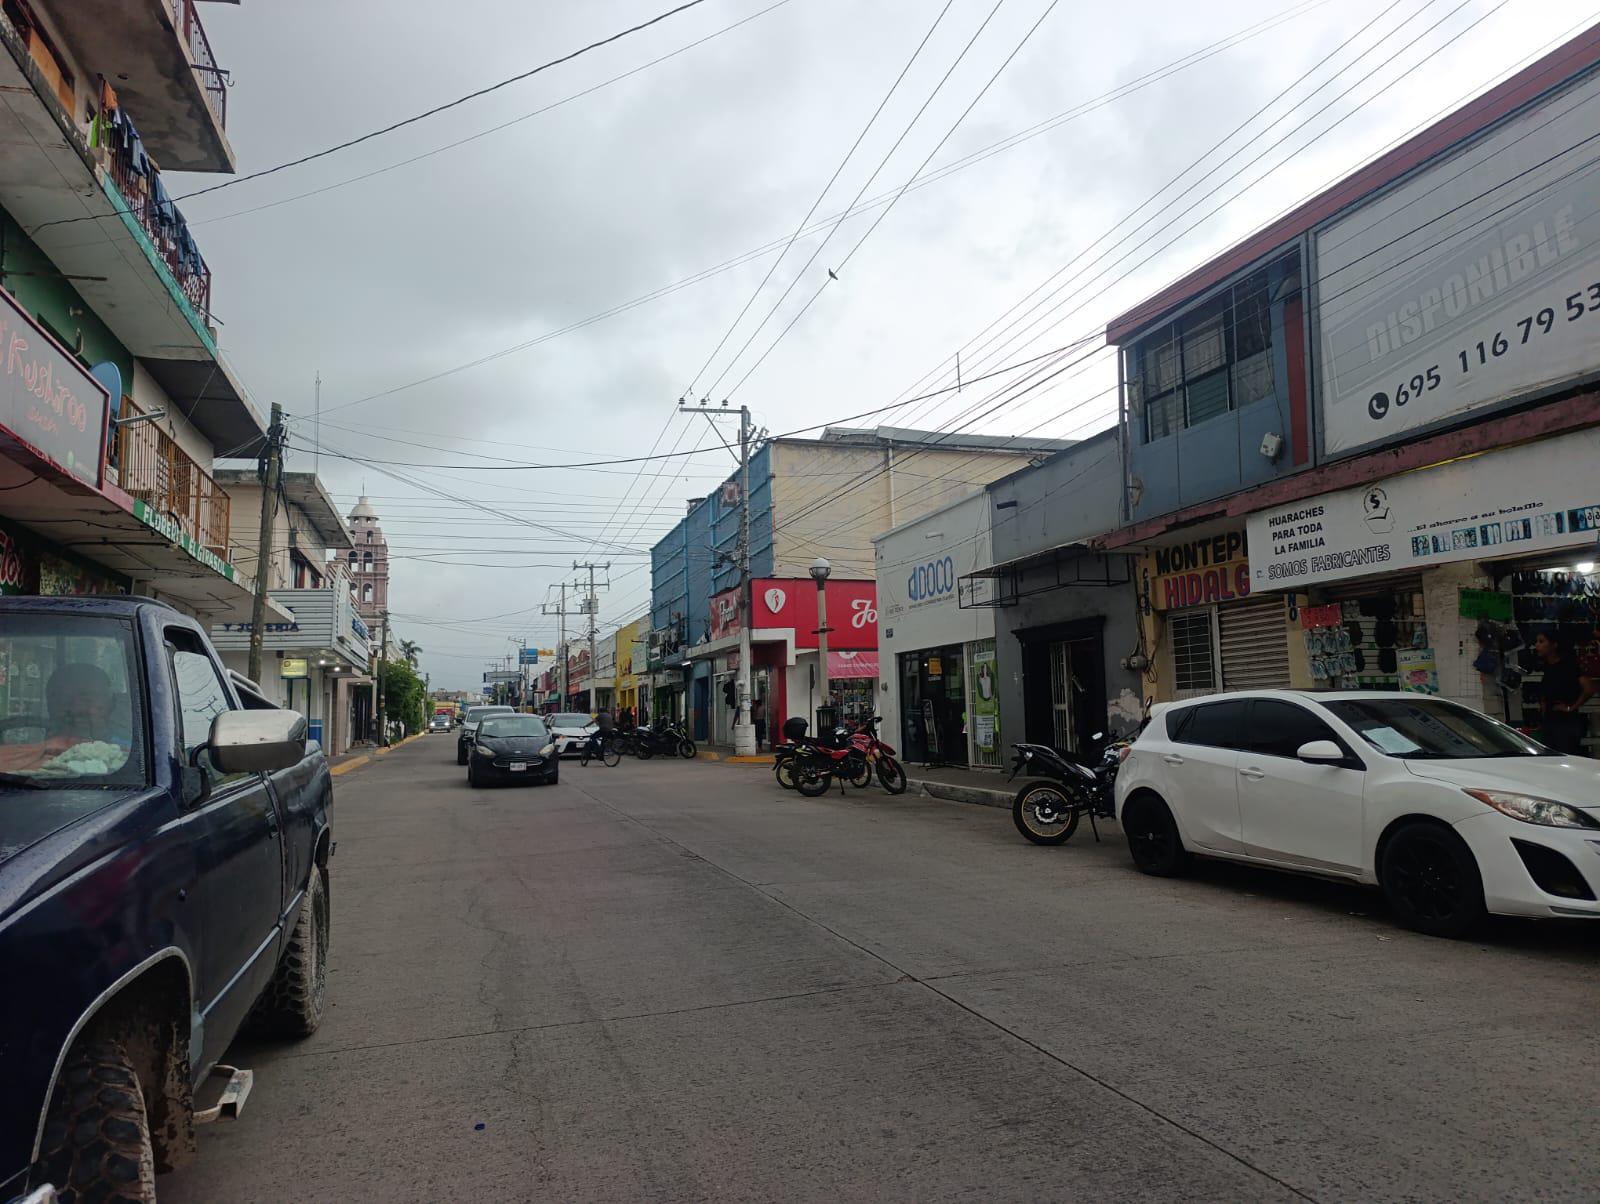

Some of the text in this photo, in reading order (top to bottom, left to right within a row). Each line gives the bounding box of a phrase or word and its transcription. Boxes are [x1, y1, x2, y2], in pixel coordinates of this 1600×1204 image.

[1366, 204, 1579, 361] DISPONIBLE
[1395, 283, 1600, 406] 695 116 79 53
[1269, 506, 1324, 527] HUARACHES
[1272, 522, 1322, 541] PARA TODA
[1275, 537, 1325, 555] LA FAMILIA
[197, 545, 226, 577] GIRASOL
[1268, 544, 1391, 580] SOMOS FABRICANTES
[224, 623, 232, 631] Y
